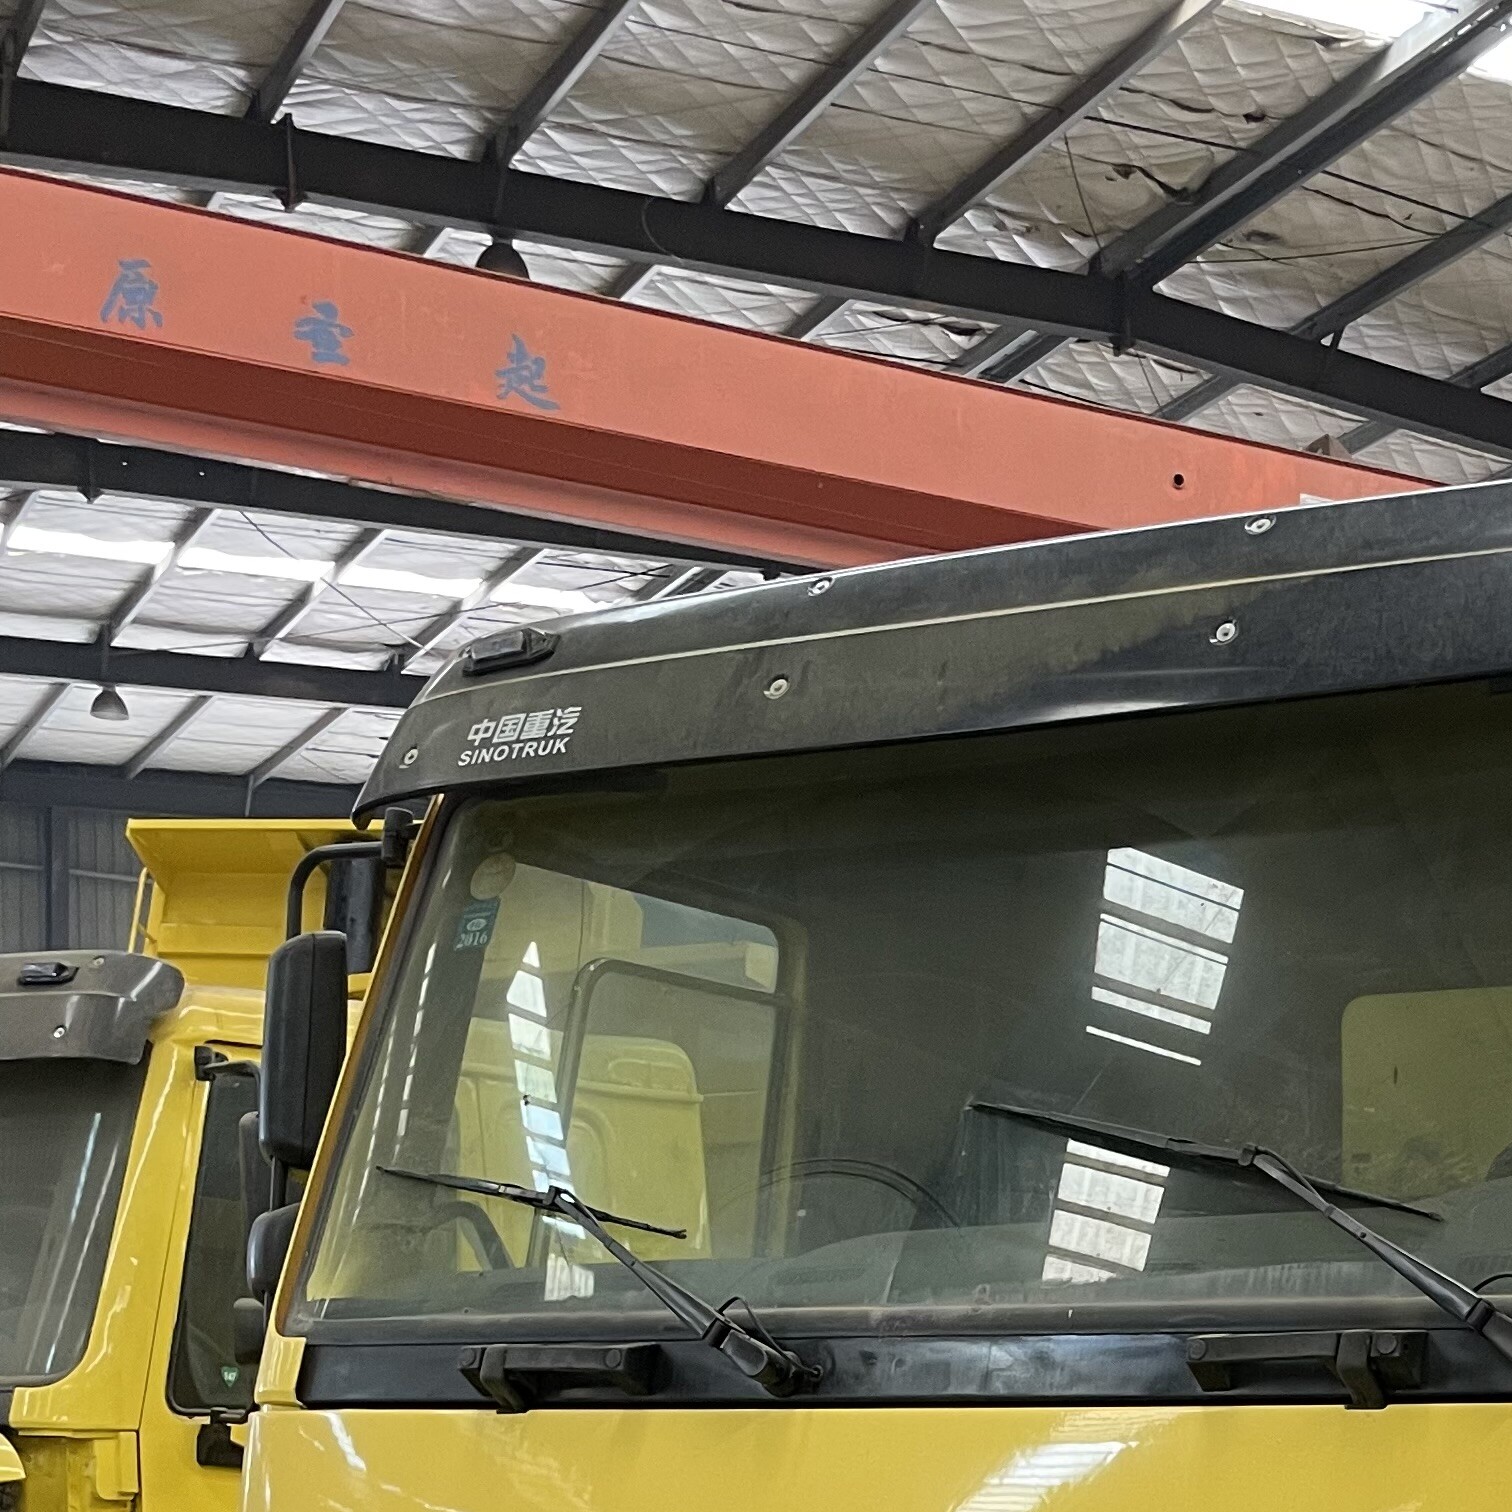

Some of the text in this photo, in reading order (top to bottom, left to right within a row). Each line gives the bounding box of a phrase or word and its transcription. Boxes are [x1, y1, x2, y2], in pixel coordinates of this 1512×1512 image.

[467, 706, 582, 746] 中国重汽
[457, 736, 571, 767] SINOTRUK
